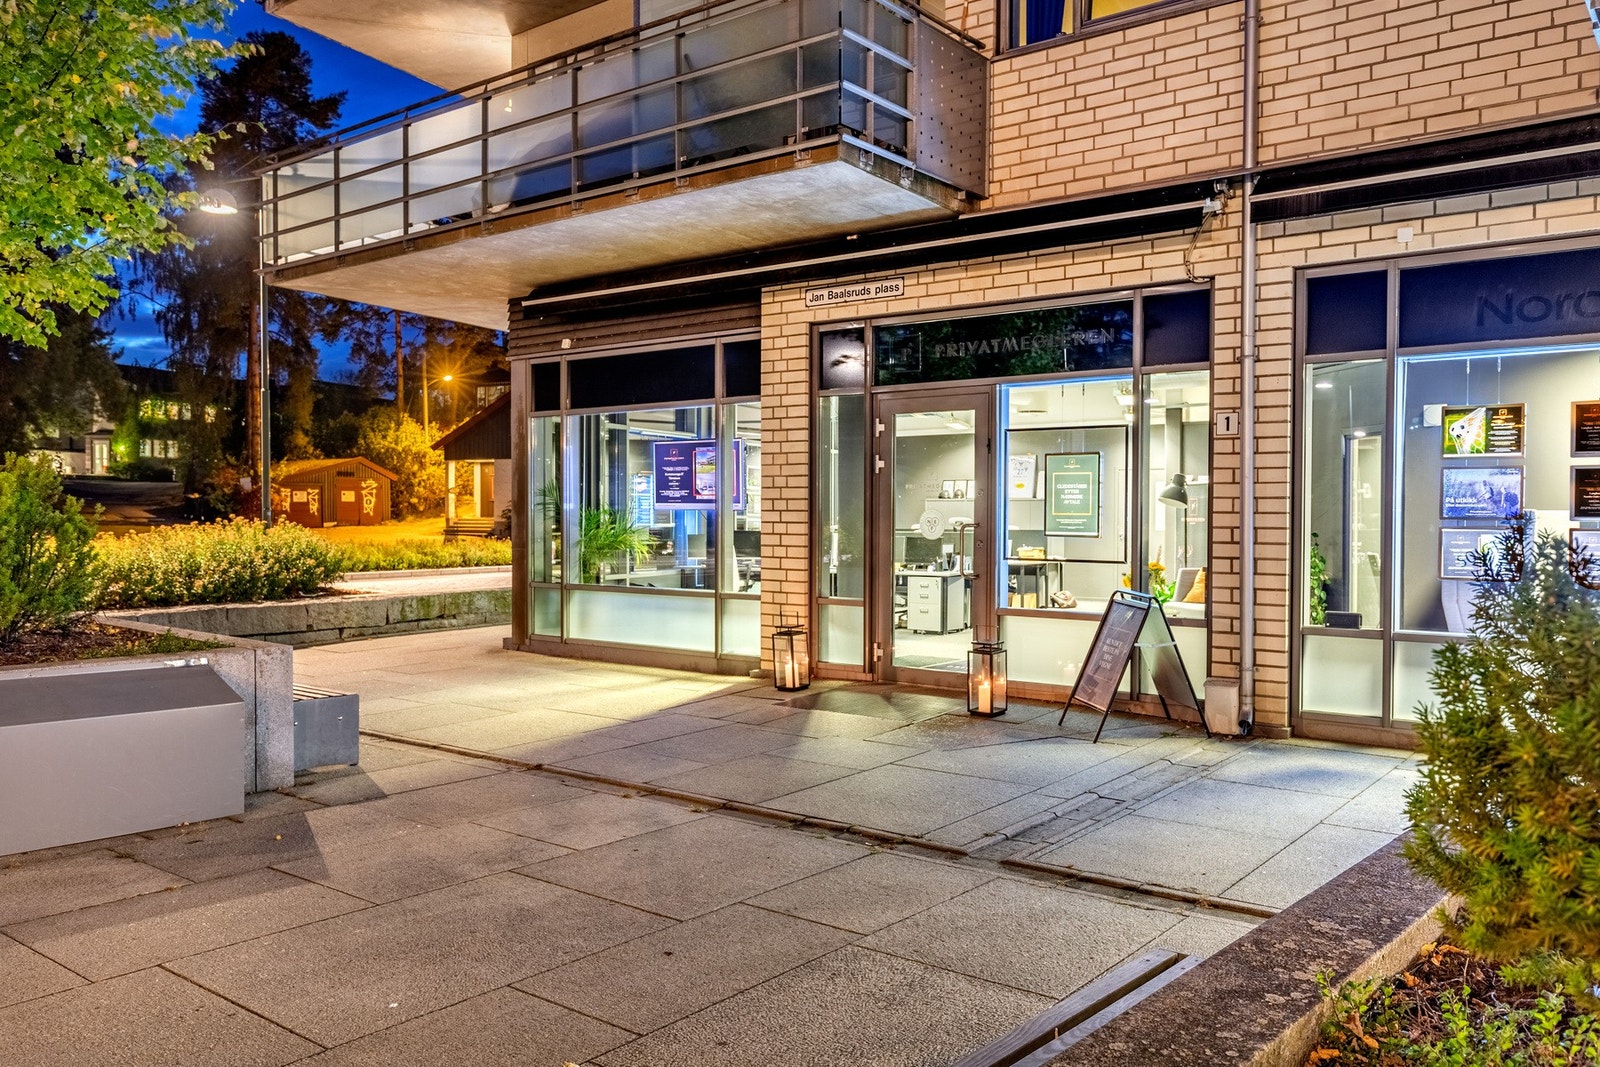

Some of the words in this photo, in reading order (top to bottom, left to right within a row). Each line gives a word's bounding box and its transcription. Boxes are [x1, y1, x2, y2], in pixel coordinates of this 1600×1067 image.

[809, 293, 824, 303] Jan
[827, 286, 871, 300] Baalsruds
[874, 283, 900, 296] plass
[934, 327, 1116, 359] PRIVATMEGLEREN
[1224, 416, 1230, 432] 1
